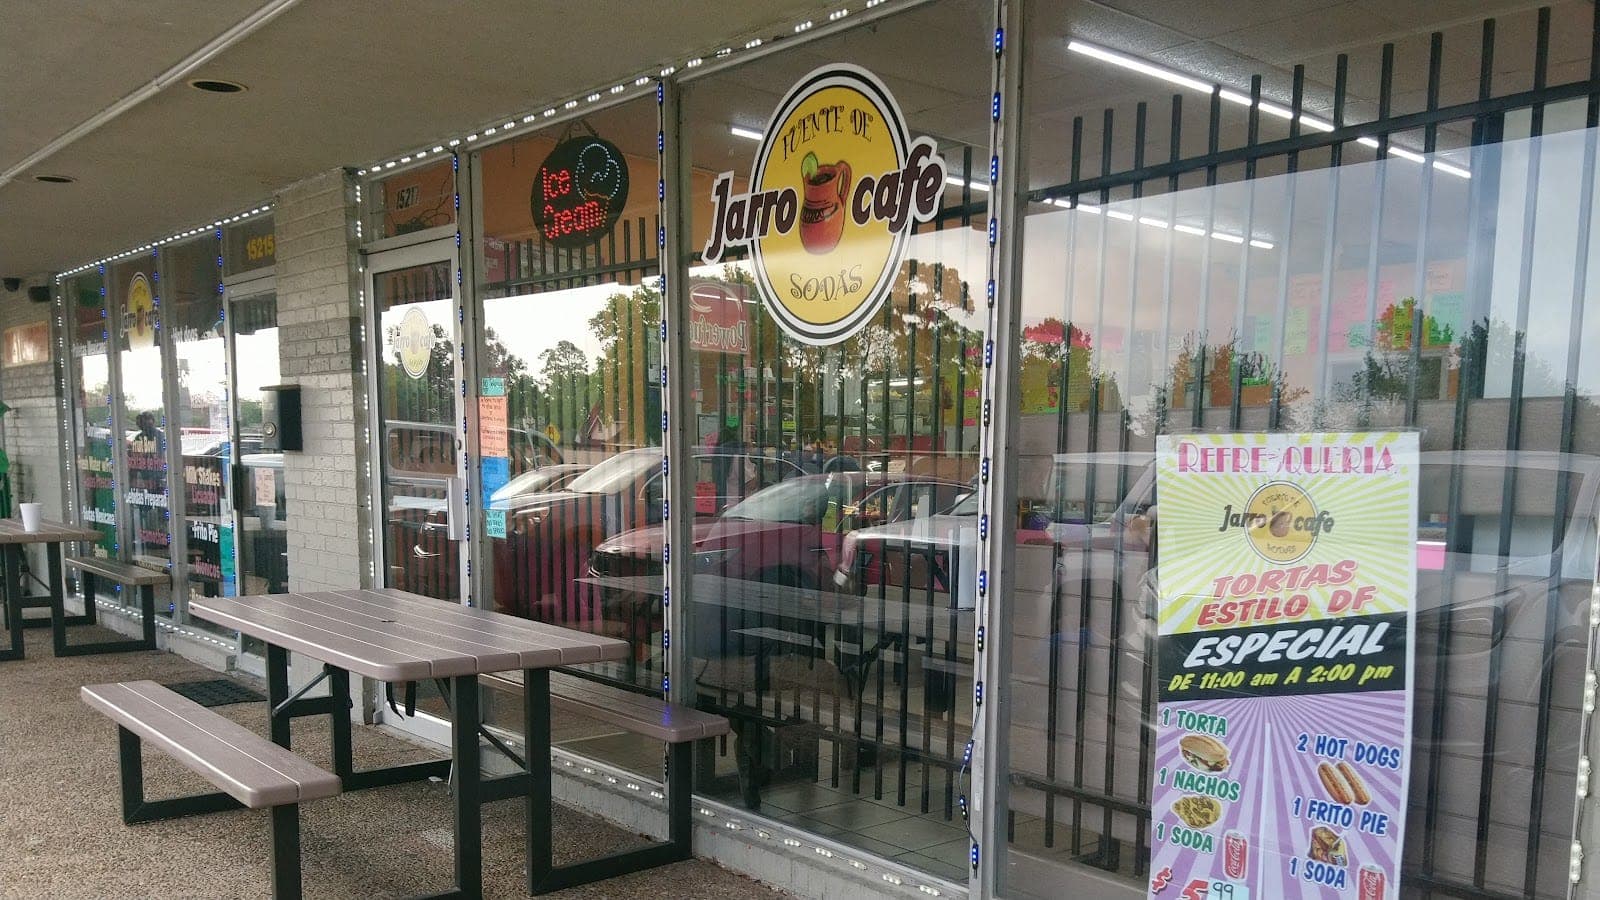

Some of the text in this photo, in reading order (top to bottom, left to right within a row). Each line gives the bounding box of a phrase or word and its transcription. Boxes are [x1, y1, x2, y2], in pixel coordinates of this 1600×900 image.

[782, 105, 874, 161] FUENTE DE
[541, 167, 571, 201] Ice
[704, 143, 943, 261] Jarro cafe
[247, 234, 275, 260] 15215
[789, 264, 863, 302] SODAS
[208, 522, 219, 543] Pie
[1219, 504, 1335, 537] Jarro cafe
[1212, 560, 1356, 599] TORTAS
[1197, 585, 1377, 627] ESTILO DF
[1183, 622, 1391, 668] ESPECIAL
[1168, 664, 1394, 691] DE 11:00 am A 2:00 pm
[1162, 708, 1228, 736] 1 TORTA
[1297, 733, 1400, 769] 2 HOT DOGS
[1159, 767, 1240, 801] 1 NACHOS
[1293, 797, 1388, 834] 1 FRITO PIE
[1156, 823, 1214, 852] 1 SODA
[1290, 857, 1346, 888] 1 SODA
